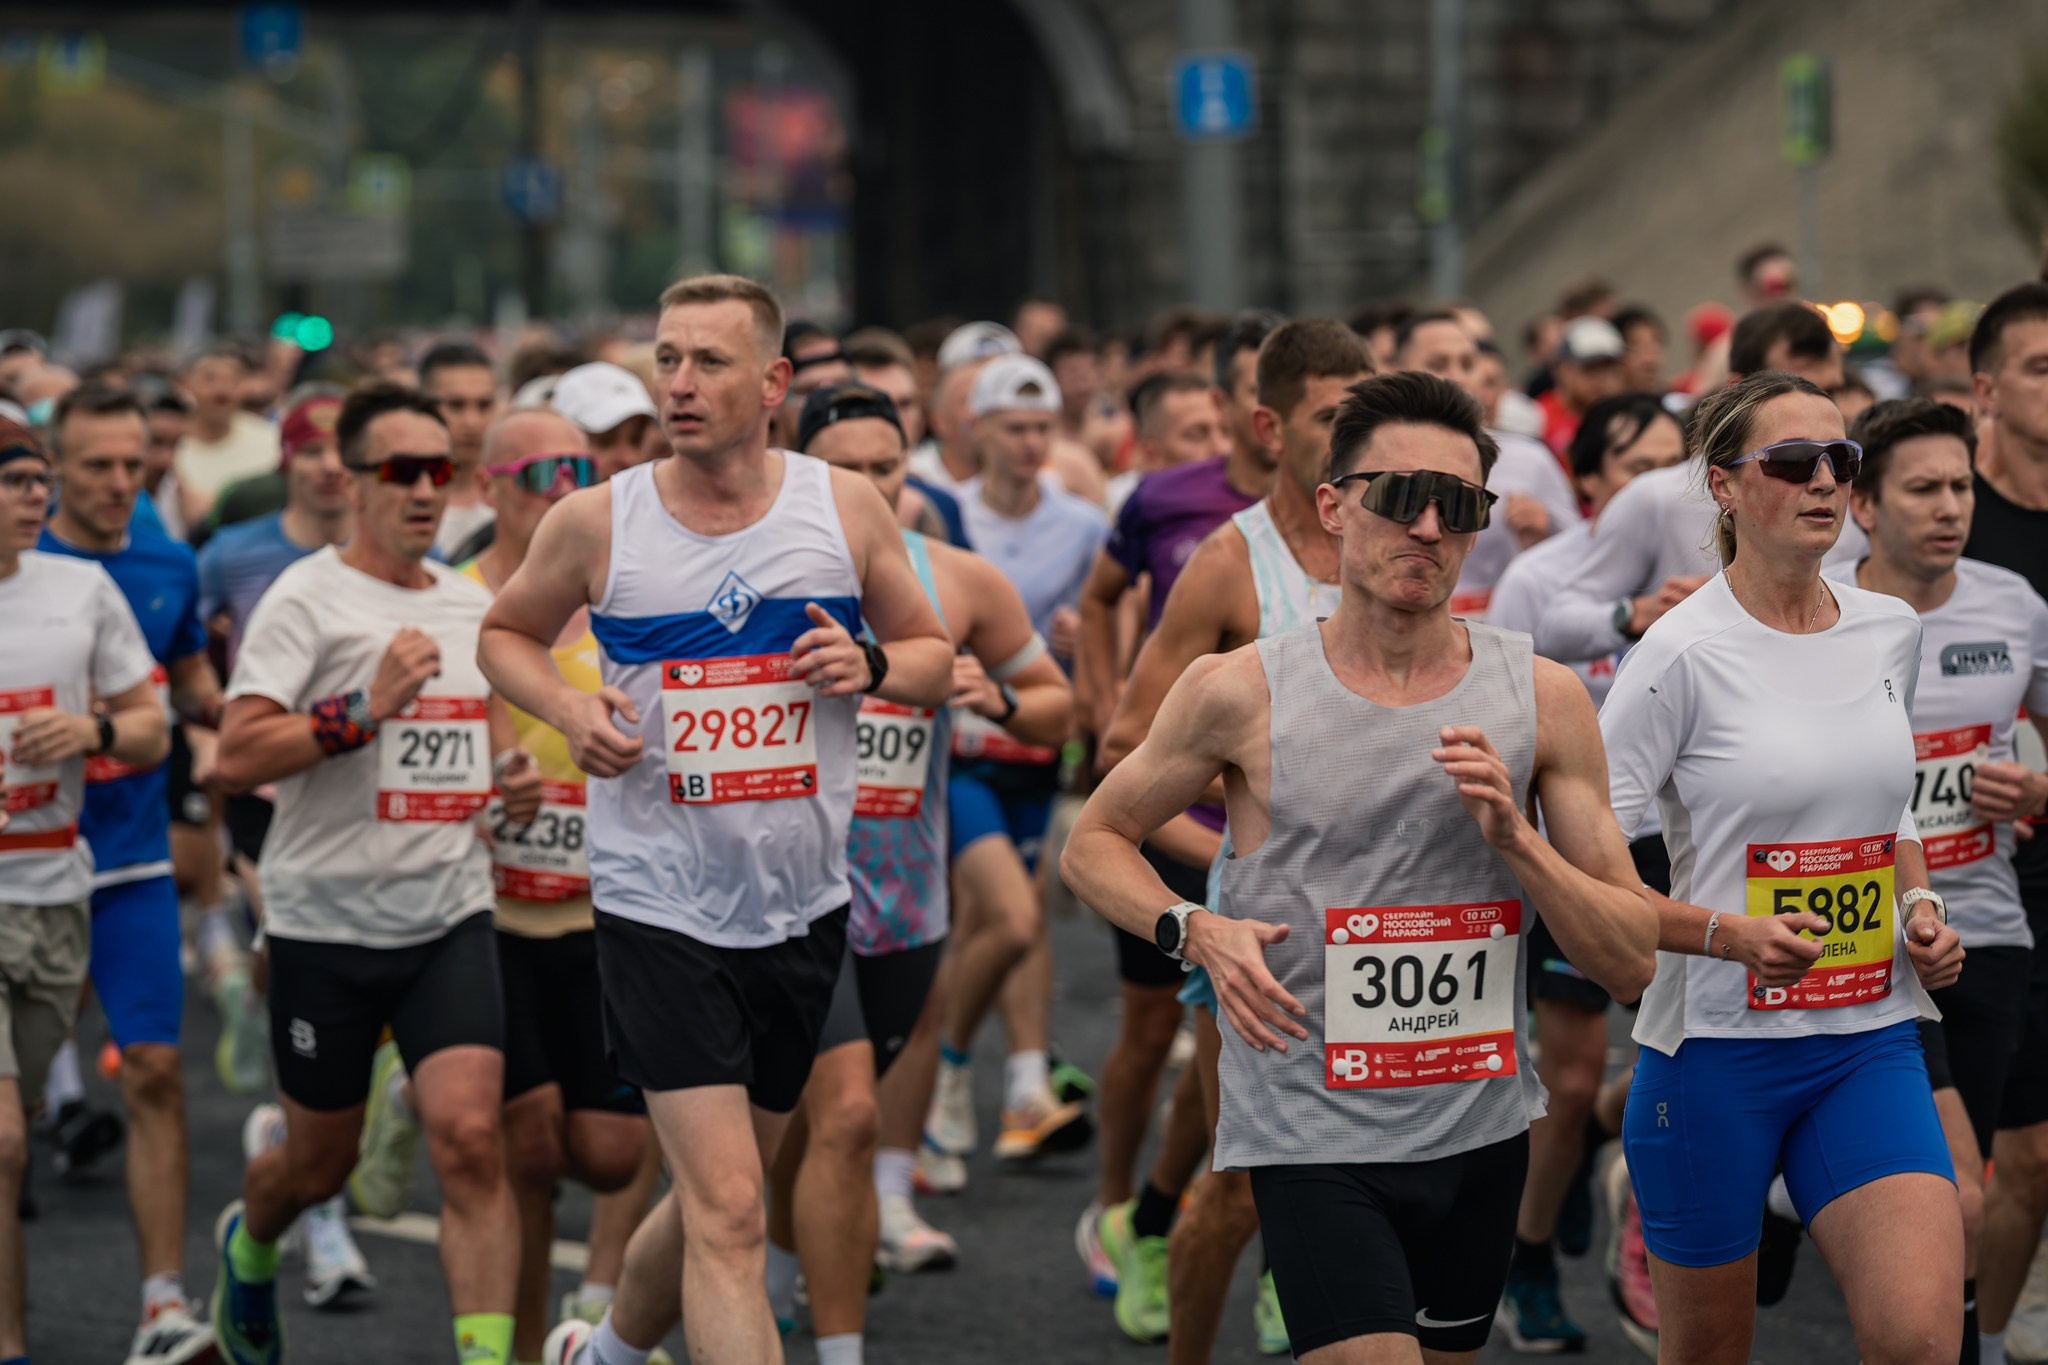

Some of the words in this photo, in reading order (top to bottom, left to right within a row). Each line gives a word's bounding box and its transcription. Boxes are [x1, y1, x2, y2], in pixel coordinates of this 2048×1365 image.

[672, 701, 810, 752] 29827
[399, 729, 474, 767] 2971
[856, 724, 926, 764] 809
[689, 775, 705, 797] B
[1911, 763, 1976, 812] 740
[1800, 851, 1854, 864] МОСКОВСКИЙ
[1863, 845, 1871, 853] 10
[1800, 862, 1841, 872] МАРАФОН
[1383, 911, 1434, 920] СБЕРПРАЙМ
[1466, 911, 1478, 920] 10
[1774, 881, 1881, 937] 5882
[1383, 917, 1451, 929] МОСКОВСКИЙ
[1467, 924, 1493, 934] 202
[1383, 928, 1434, 938] МАРАФОН
[1820, 941, 1857, 958] ЛЕНА
[1352, 950, 1487, 1009] 3061
[1388, 1010, 1459, 1033] АНДРЕЙ
[1345, 1050, 1369, 1081] B
